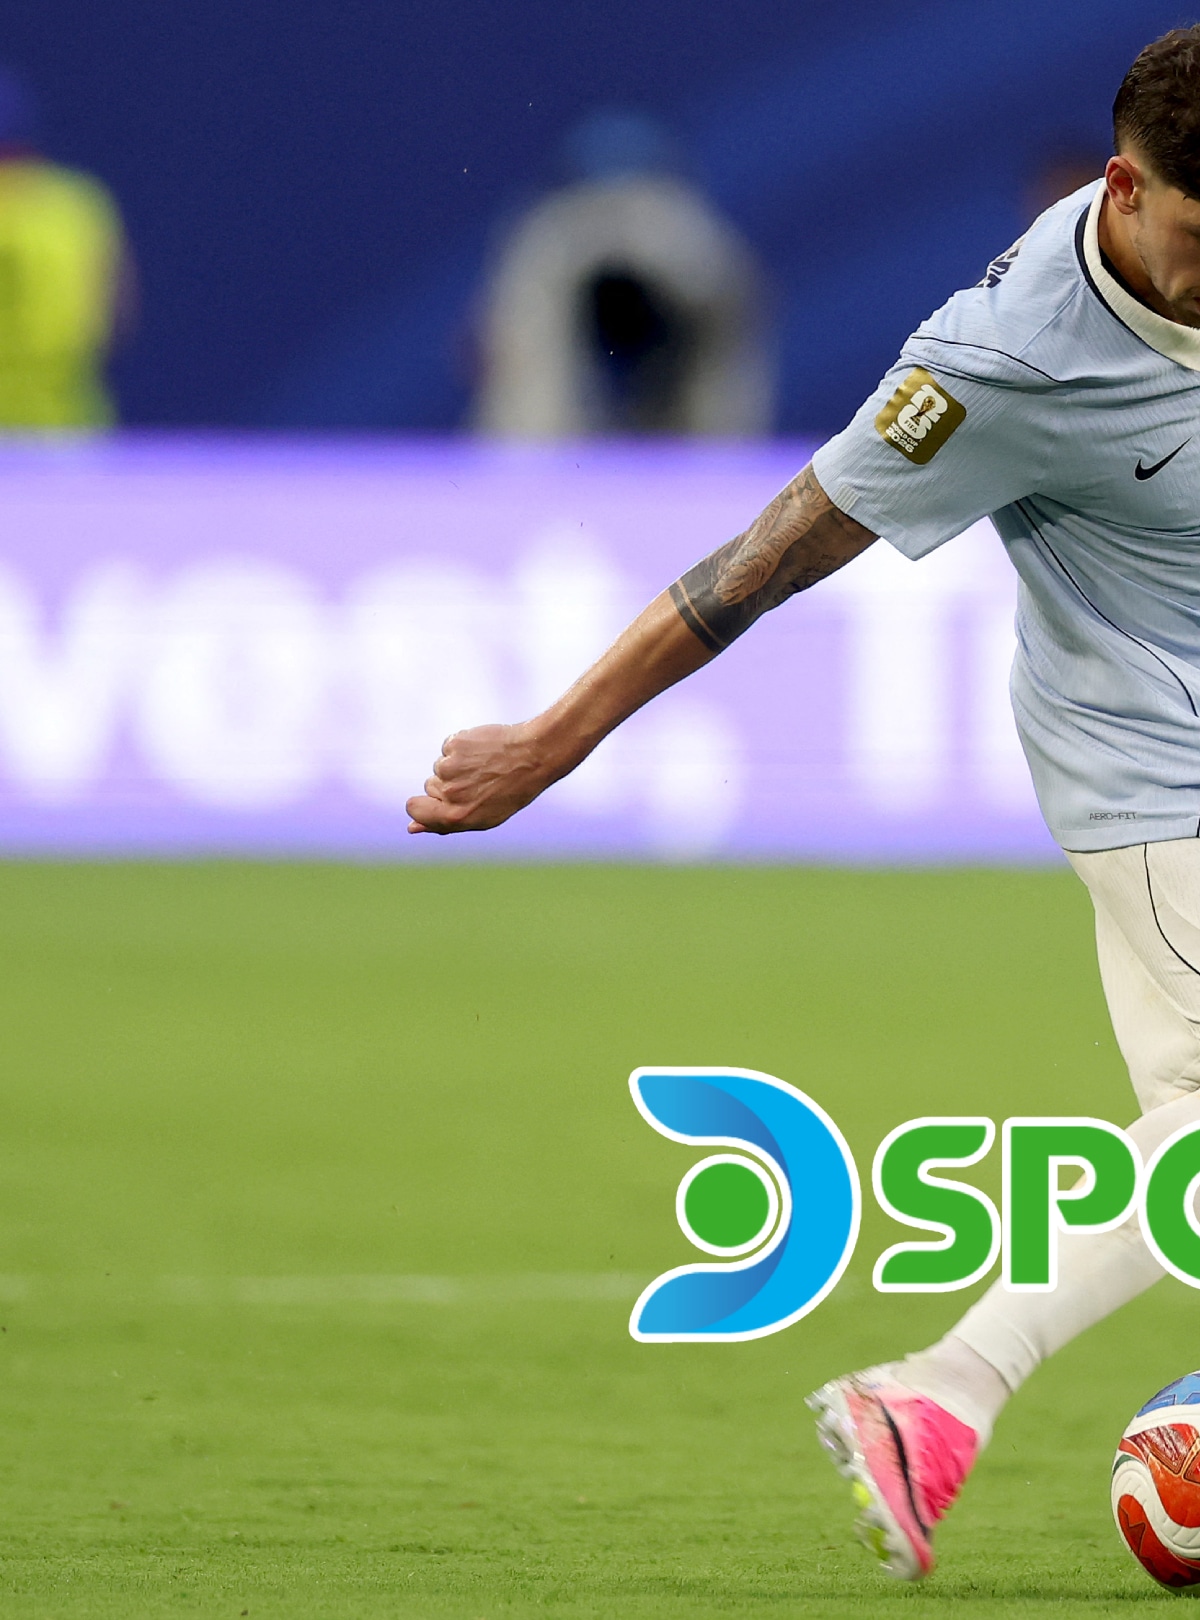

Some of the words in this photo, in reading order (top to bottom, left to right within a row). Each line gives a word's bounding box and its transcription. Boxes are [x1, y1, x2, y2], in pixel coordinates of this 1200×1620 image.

[891, 421, 908, 438] WORLD
[907, 437, 918, 447] CUP
[904, 420, 917, 433] FIFA
[886, 427, 915, 453] 2026
[1089, 811, 1137, 820] AERO-FIT
